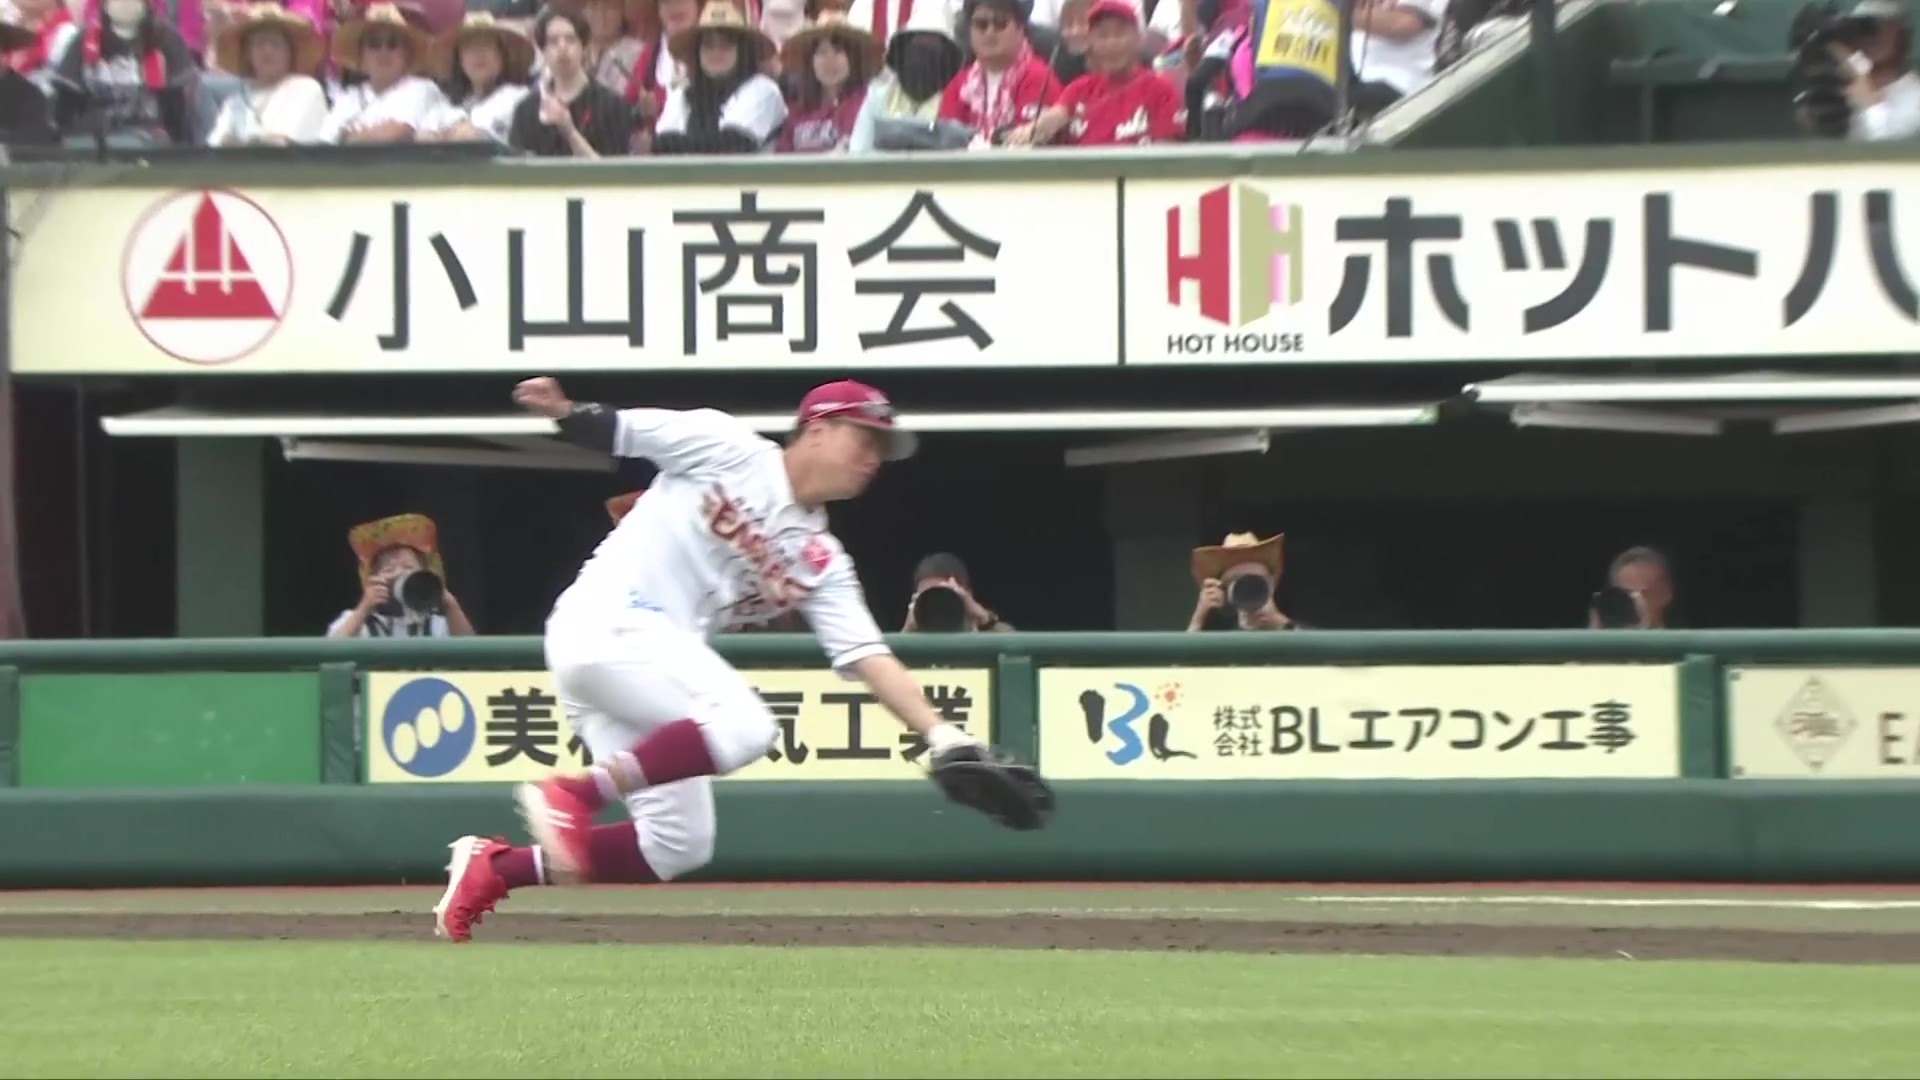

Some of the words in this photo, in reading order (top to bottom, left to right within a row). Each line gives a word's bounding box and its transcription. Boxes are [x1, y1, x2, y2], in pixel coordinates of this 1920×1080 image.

[327, 190, 1003, 356] 小山商会
[1328, 189, 1920, 338] ホットハ
[1167, 333, 1216, 354] HOT
[1224, 332, 1304, 353] HOUSE
[1212, 705, 1263, 730] 株式
[1269, 700, 1637, 755] BLエアコン工事
[1212, 732, 1263, 757] 会社
